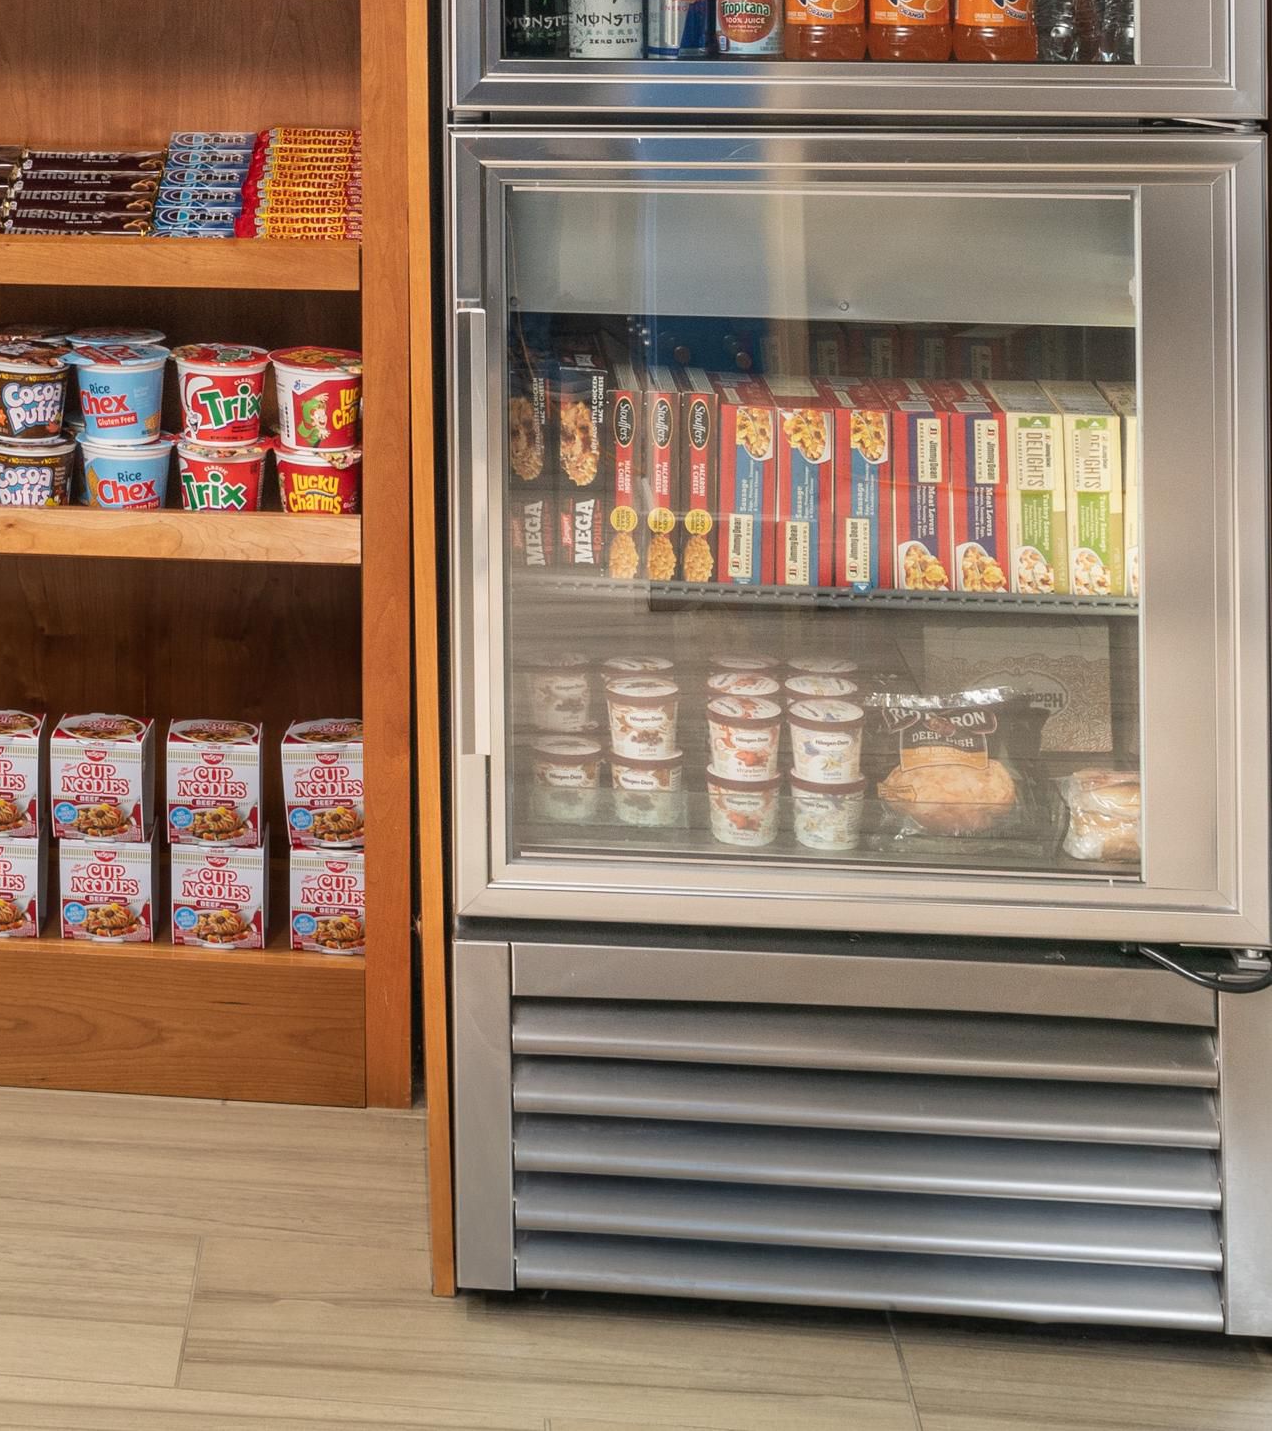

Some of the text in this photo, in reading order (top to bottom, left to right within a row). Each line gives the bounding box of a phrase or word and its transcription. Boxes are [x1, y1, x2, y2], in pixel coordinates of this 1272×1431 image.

[721, 0, 770, 16] Tropicana
[806, 6, 835, 19] ORANGE
[897, 8, 927, 19] ORANGE
[3, 383, 63, 407] Cocoa
[89, 383, 110, 394] Rice
[80, 391, 129, 415] Chex
[199, 383, 262, 428] Trix
[97, 415, 136, 425] Gluten Free
[620, 402, 631, 442] Stouffer's
[657, 403, 667, 442] Stouffer's
[694, 405, 705, 444] Stouffer's
[1027, 432, 1044, 488] DELIGHTS
[117, 471, 142, 483] Rice
[291, 474, 339, 495] Lucky
[97, 478, 157, 505] Chex
[181, 471, 247, 510] Trix
[928, 486, 936, 503] Meat
[288, 491, 342, 514] Charms
[524, 500, 546, 566] MEGA
[575, 499, 595, 564] MEGA
[77, 763, 116, 779] CUP
[193, 766, 233, 782] CUP
[62, 777, 129, 795] NOODLES
[178, 780, 247, 798] NOODLES
